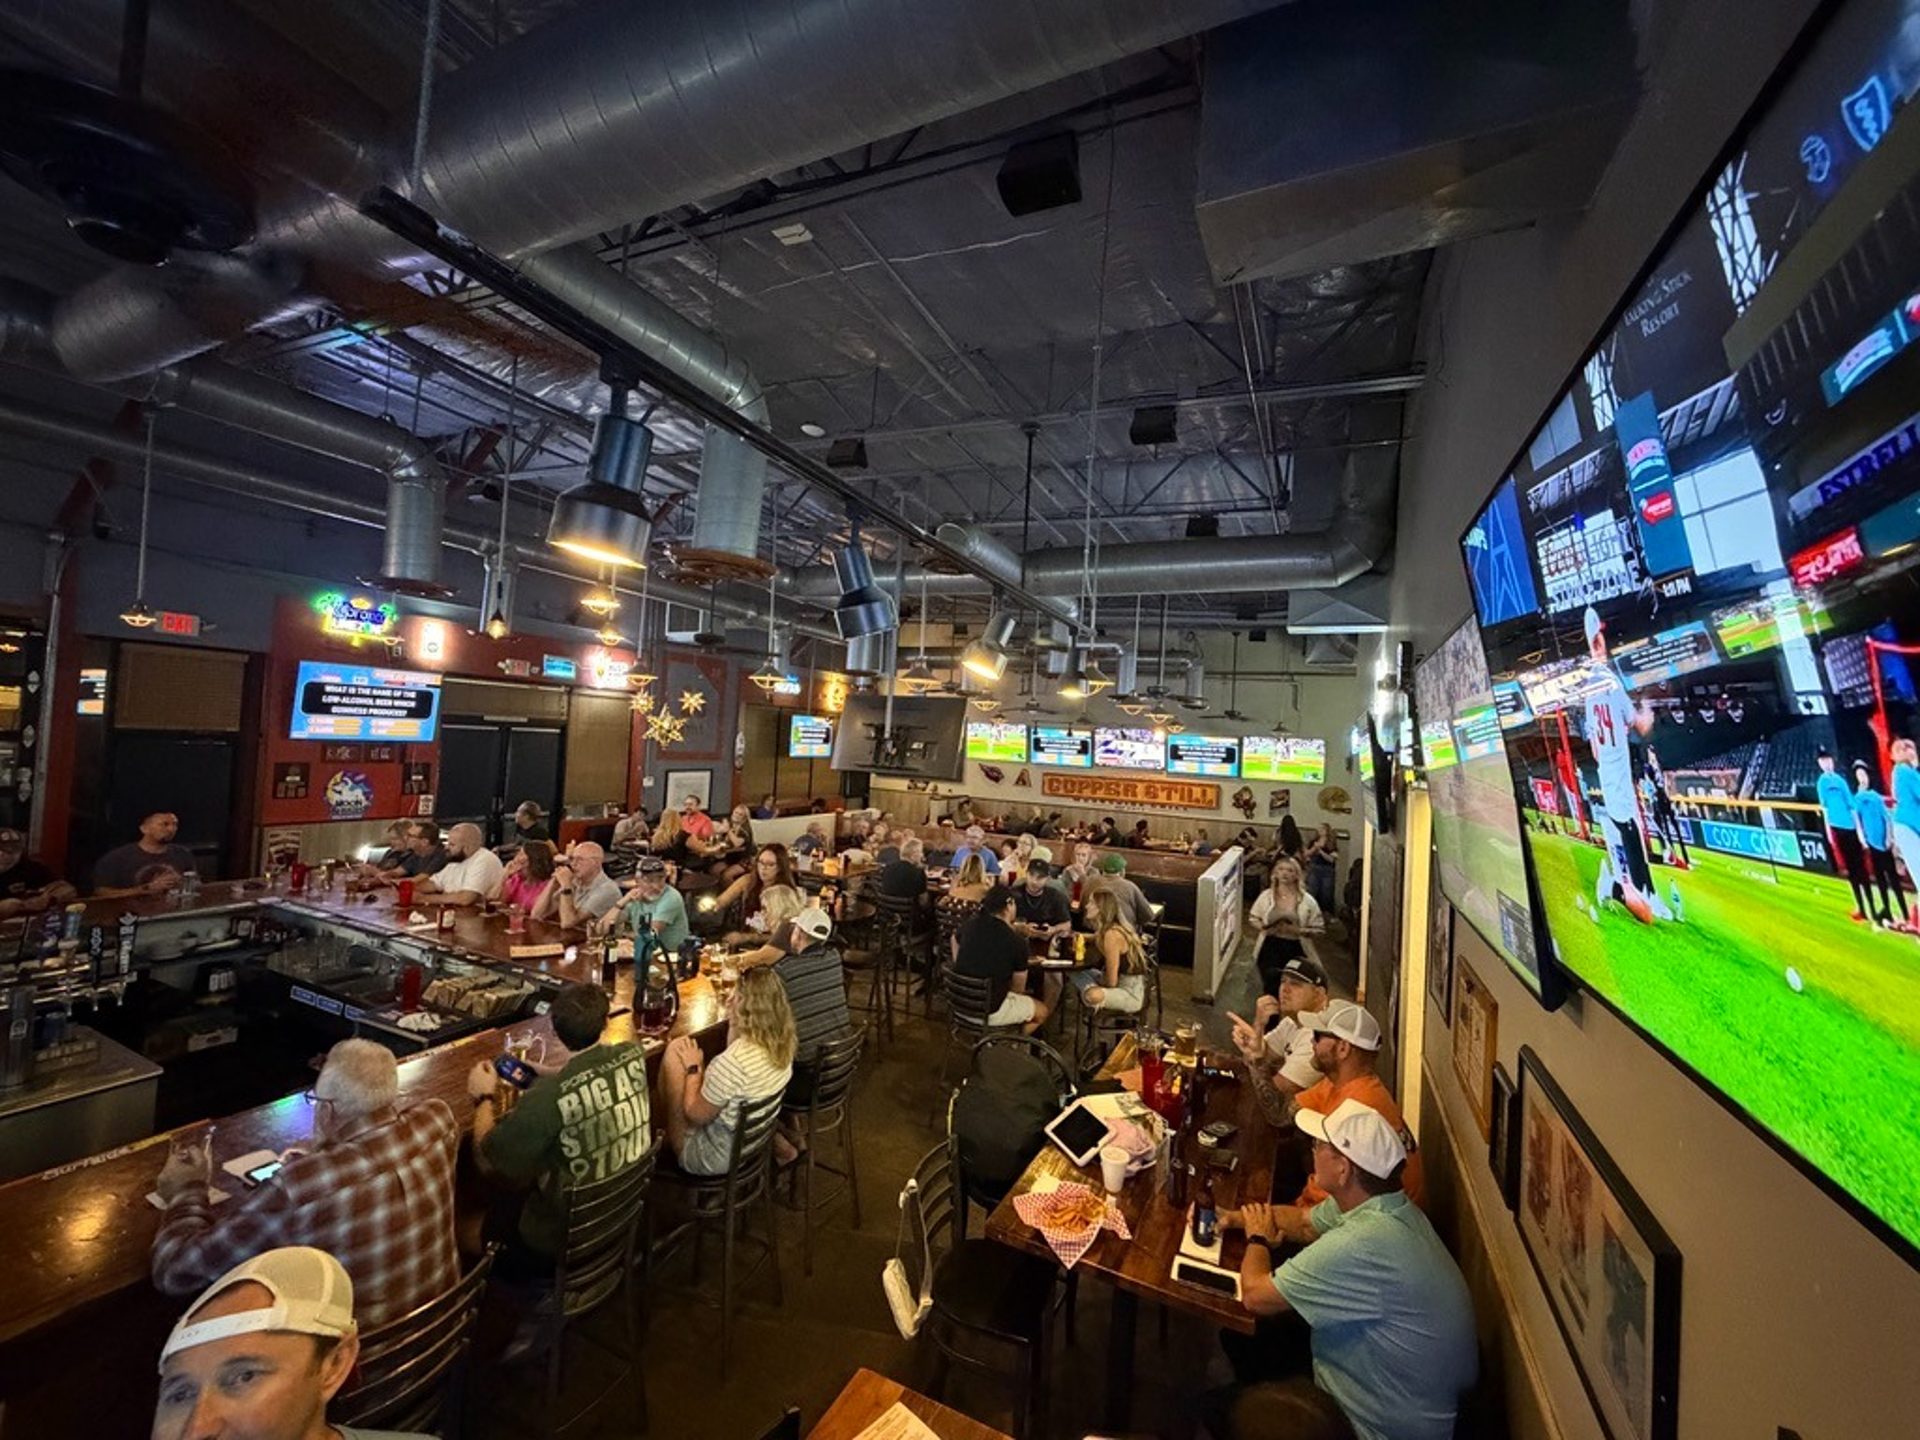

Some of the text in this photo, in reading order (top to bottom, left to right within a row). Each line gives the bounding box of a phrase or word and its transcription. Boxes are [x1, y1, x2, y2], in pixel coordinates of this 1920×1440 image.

[1593, 704, 1616, 747] 34
[1047, 777, 1139, 799] COPPER
[1144, 784, 1214, 806] STILL
[1712, 826, 1788, 857] COX COX
[1801, 839, 1827, 861] 374
[557, 1056, 648, 1126] BIG AS
[560, 1090, 650, 1158] STADIU
